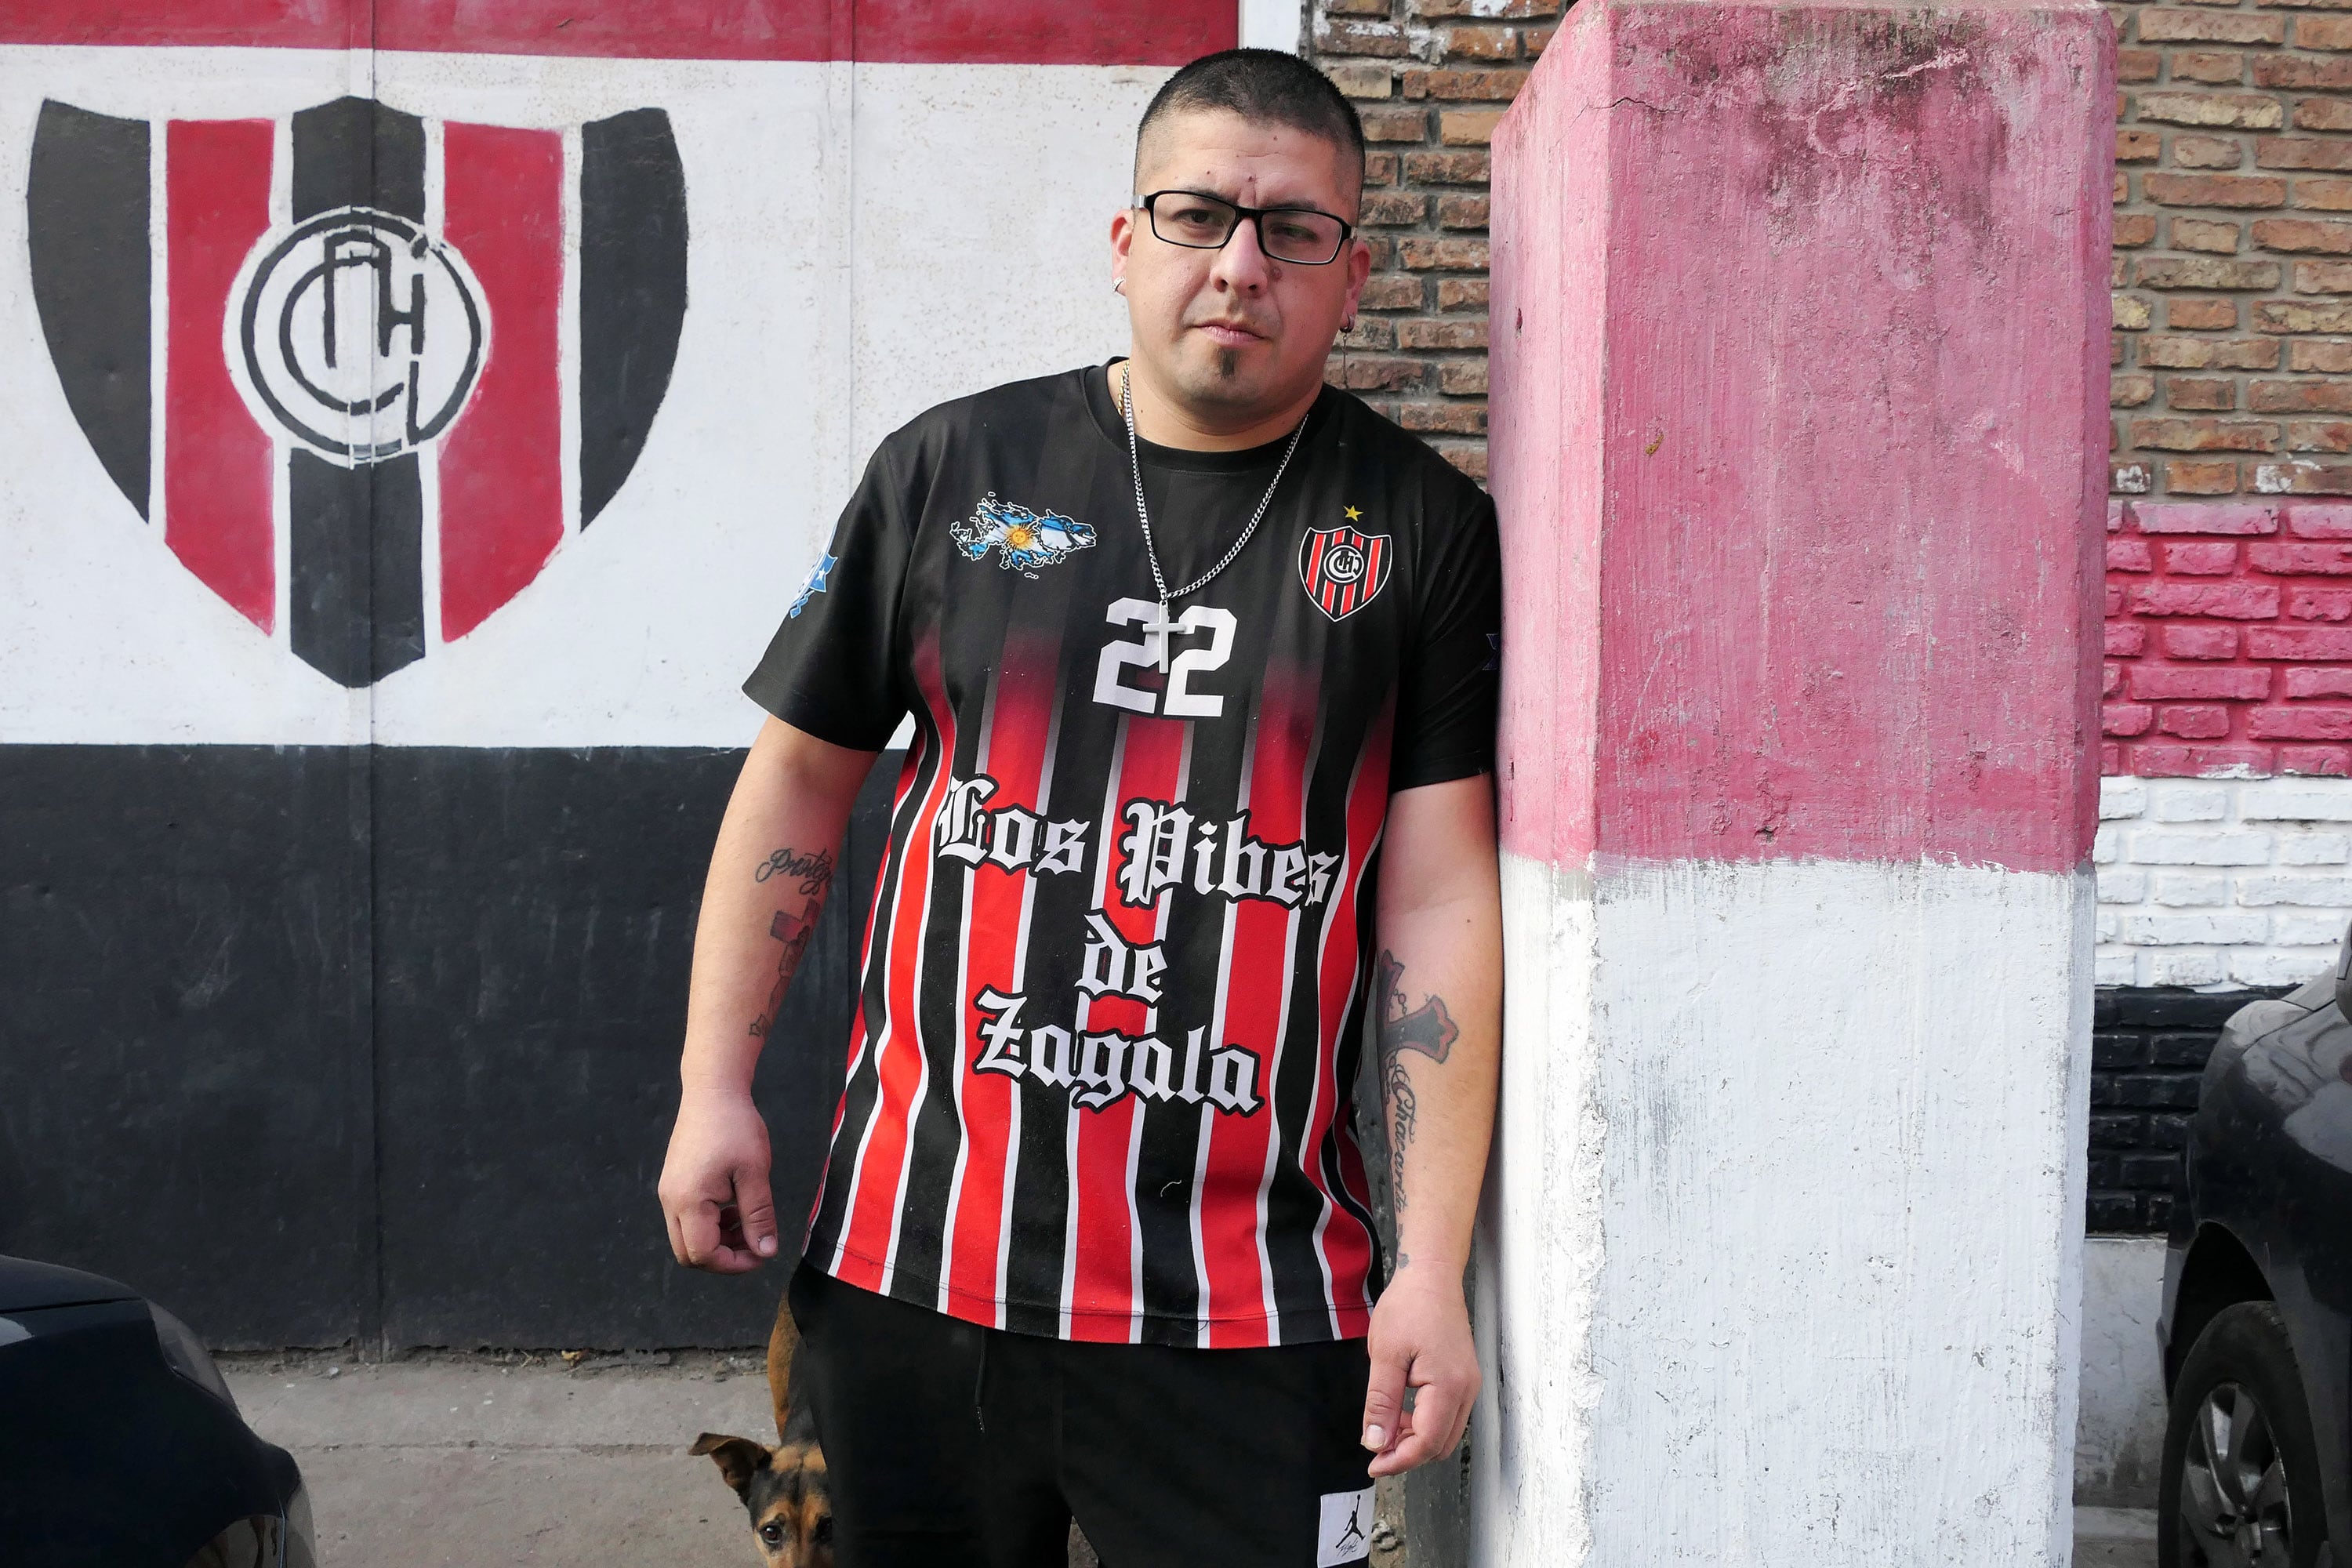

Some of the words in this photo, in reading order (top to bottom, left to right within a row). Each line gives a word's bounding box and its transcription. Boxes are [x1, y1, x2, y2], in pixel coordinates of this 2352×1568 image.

[1092, 597, 1237, 717] 22
[938, 775, 1091, 875] Los
[1120, 802, 1340, 906] Pibes
[1074, 913, 1168, 1003] de
[976, 989, 1259, 1112] Zagala
